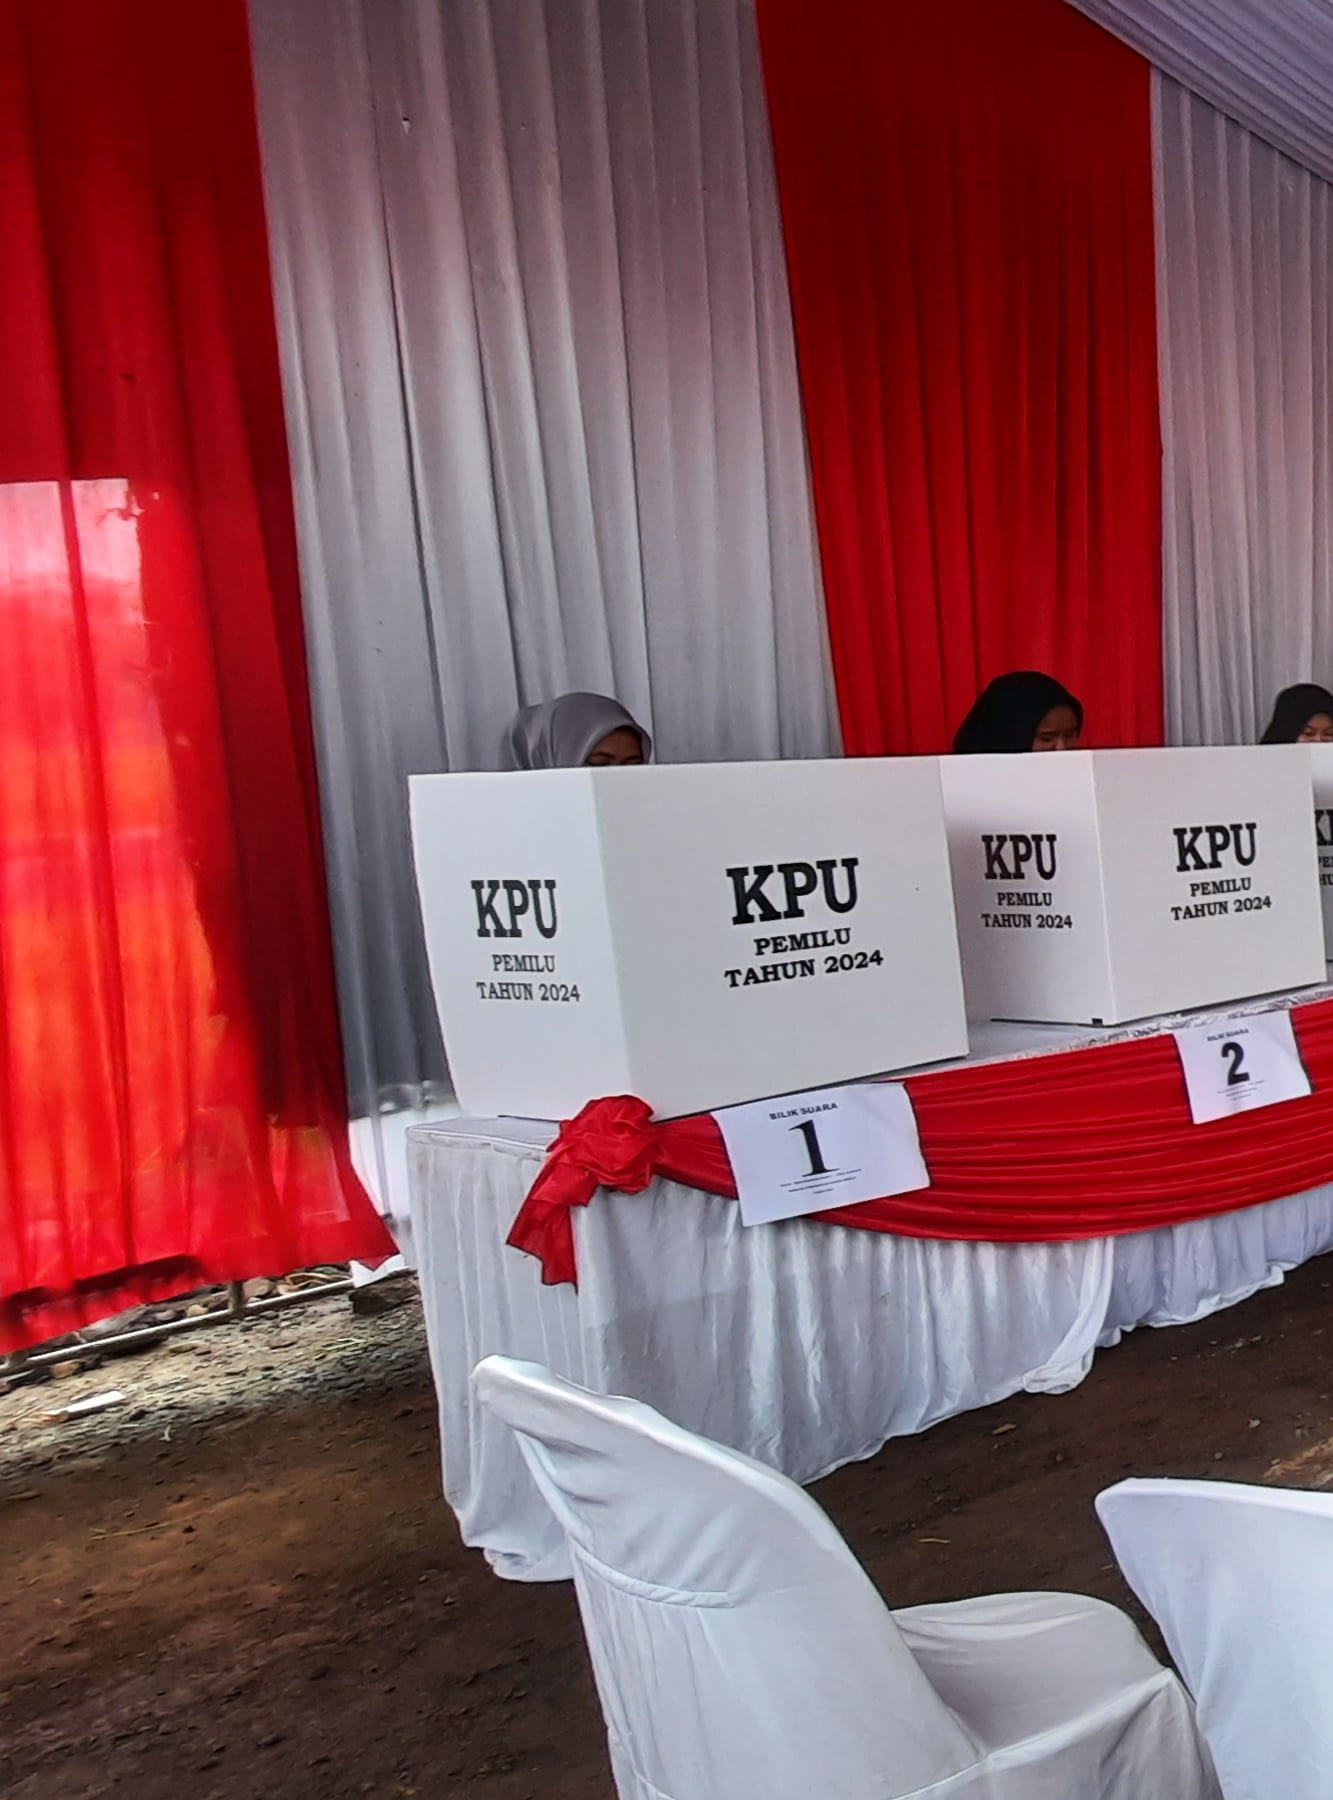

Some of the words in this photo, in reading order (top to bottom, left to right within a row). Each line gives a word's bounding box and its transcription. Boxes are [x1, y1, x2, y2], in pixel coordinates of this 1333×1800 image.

[981, 834, 1057, 880] KPU
[1173, 822, 1257, 872] KPU
[726, 857, 859, 926] KPU
[997, 892, 1052, 906] PEMILU
[1190, 877, 1252, 897] PEMILU
[471, 879, 558, 939] KPU
[981, 913, 1032, 928] TAHUN
[1036, 914, 1073, 929] 2024
[1171, 901, 1229, 921] TAHUN
[1233, 896, 1272, 913] 2024
[753, 927, 851, 956] PEMILU
[492, 954, 556, 973] PEMILU
[724, 959, 816, 988] TAHUN
[824, 949, 884, 974] 2024
[476, 981, 534, 1000] TAHUN
[538, 983, 581, 1002] 2024
[1221, 1041, 1250, 1086] 2
[769, 1109, 800, 1120] BILIK
[800, 1102, 839, 1116] SUARA
[788, 1119, 841, 1178] 1
